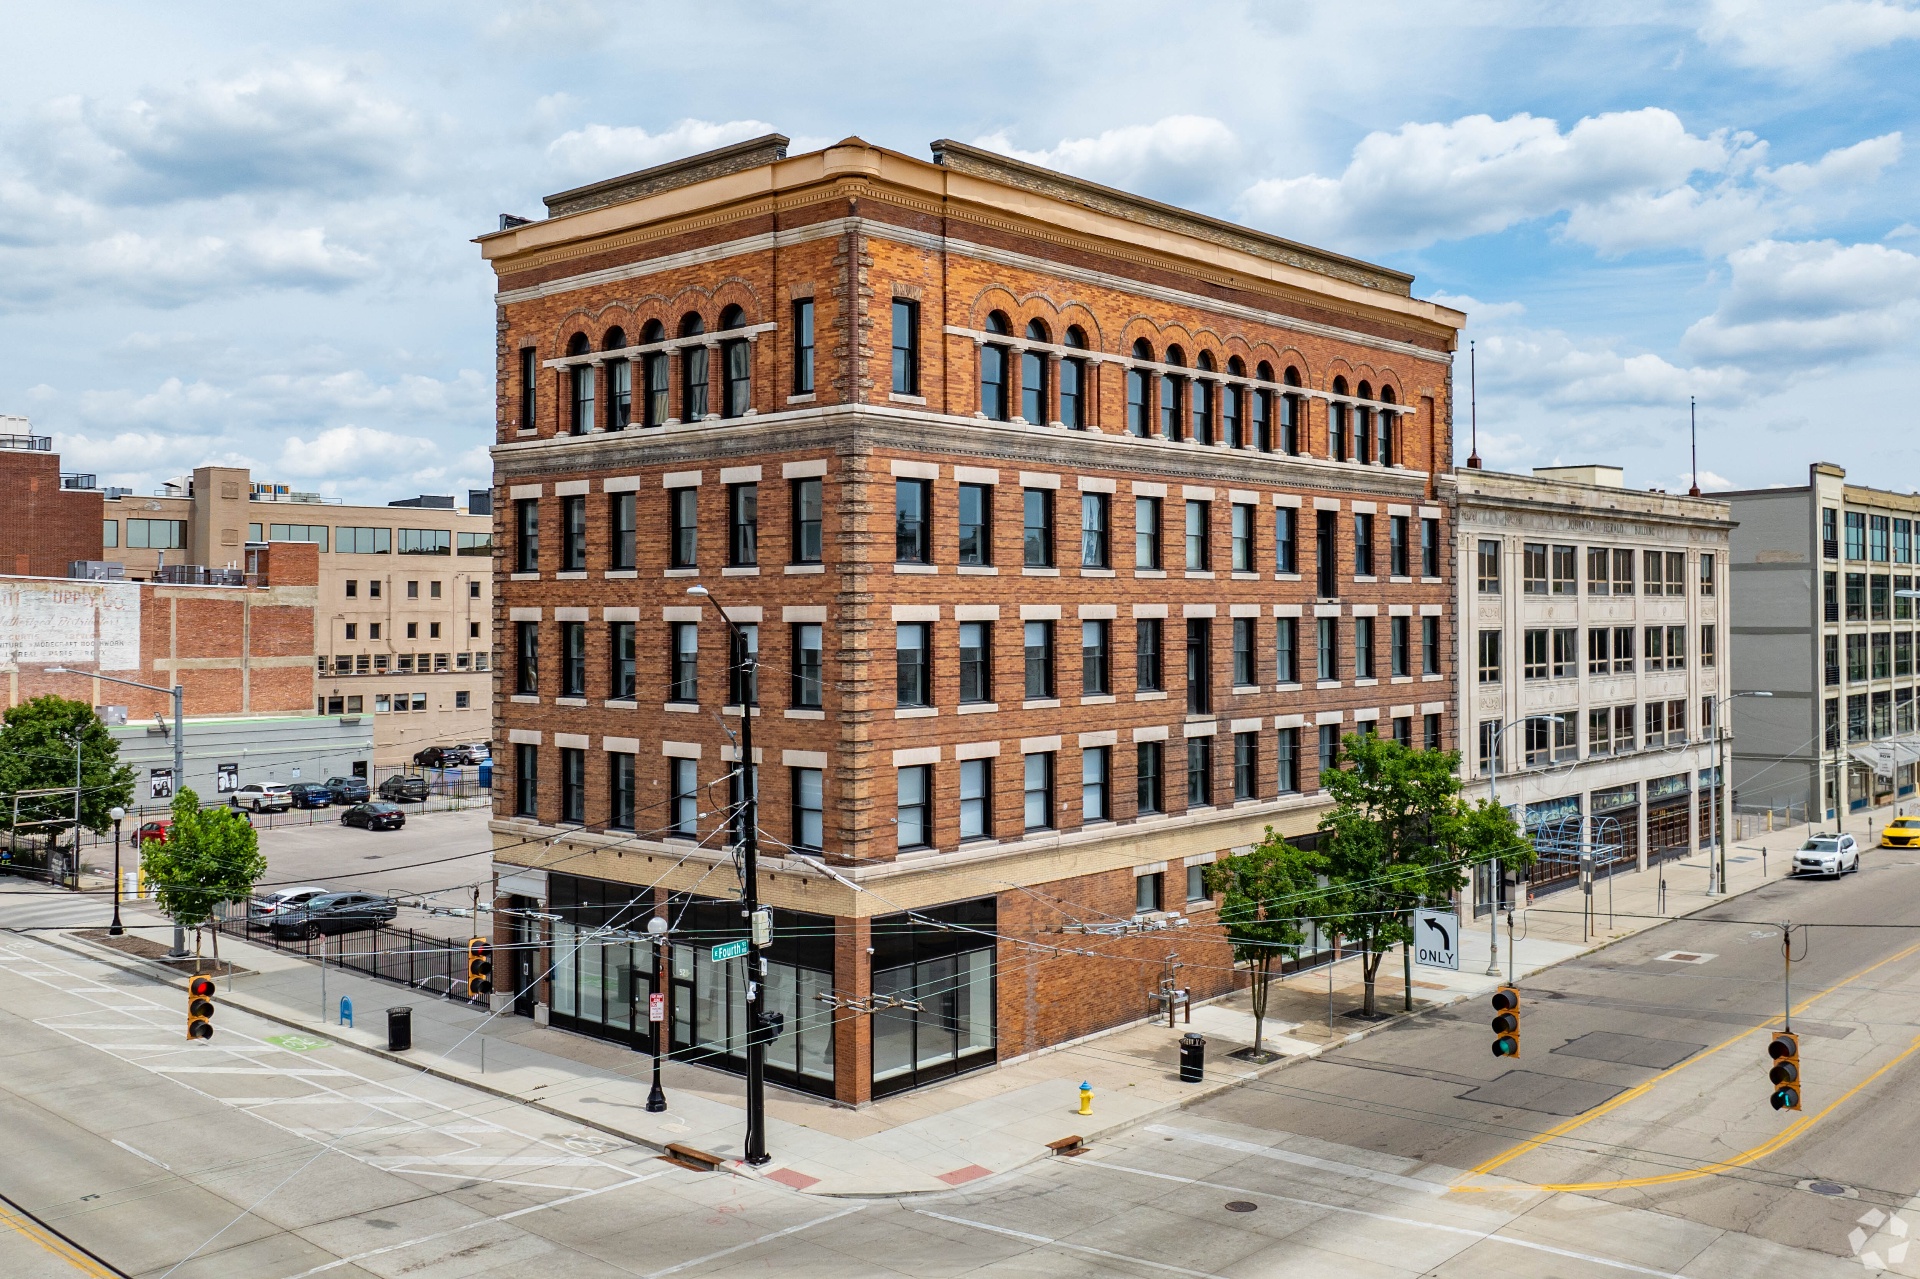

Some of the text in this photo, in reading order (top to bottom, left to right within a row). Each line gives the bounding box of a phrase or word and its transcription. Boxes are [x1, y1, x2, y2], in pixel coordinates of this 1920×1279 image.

[1603, 523, 1624, 534] HERALD
[718, 942, 741, 958] Fourth
[1419, 948, 1454, 964] ONLY
